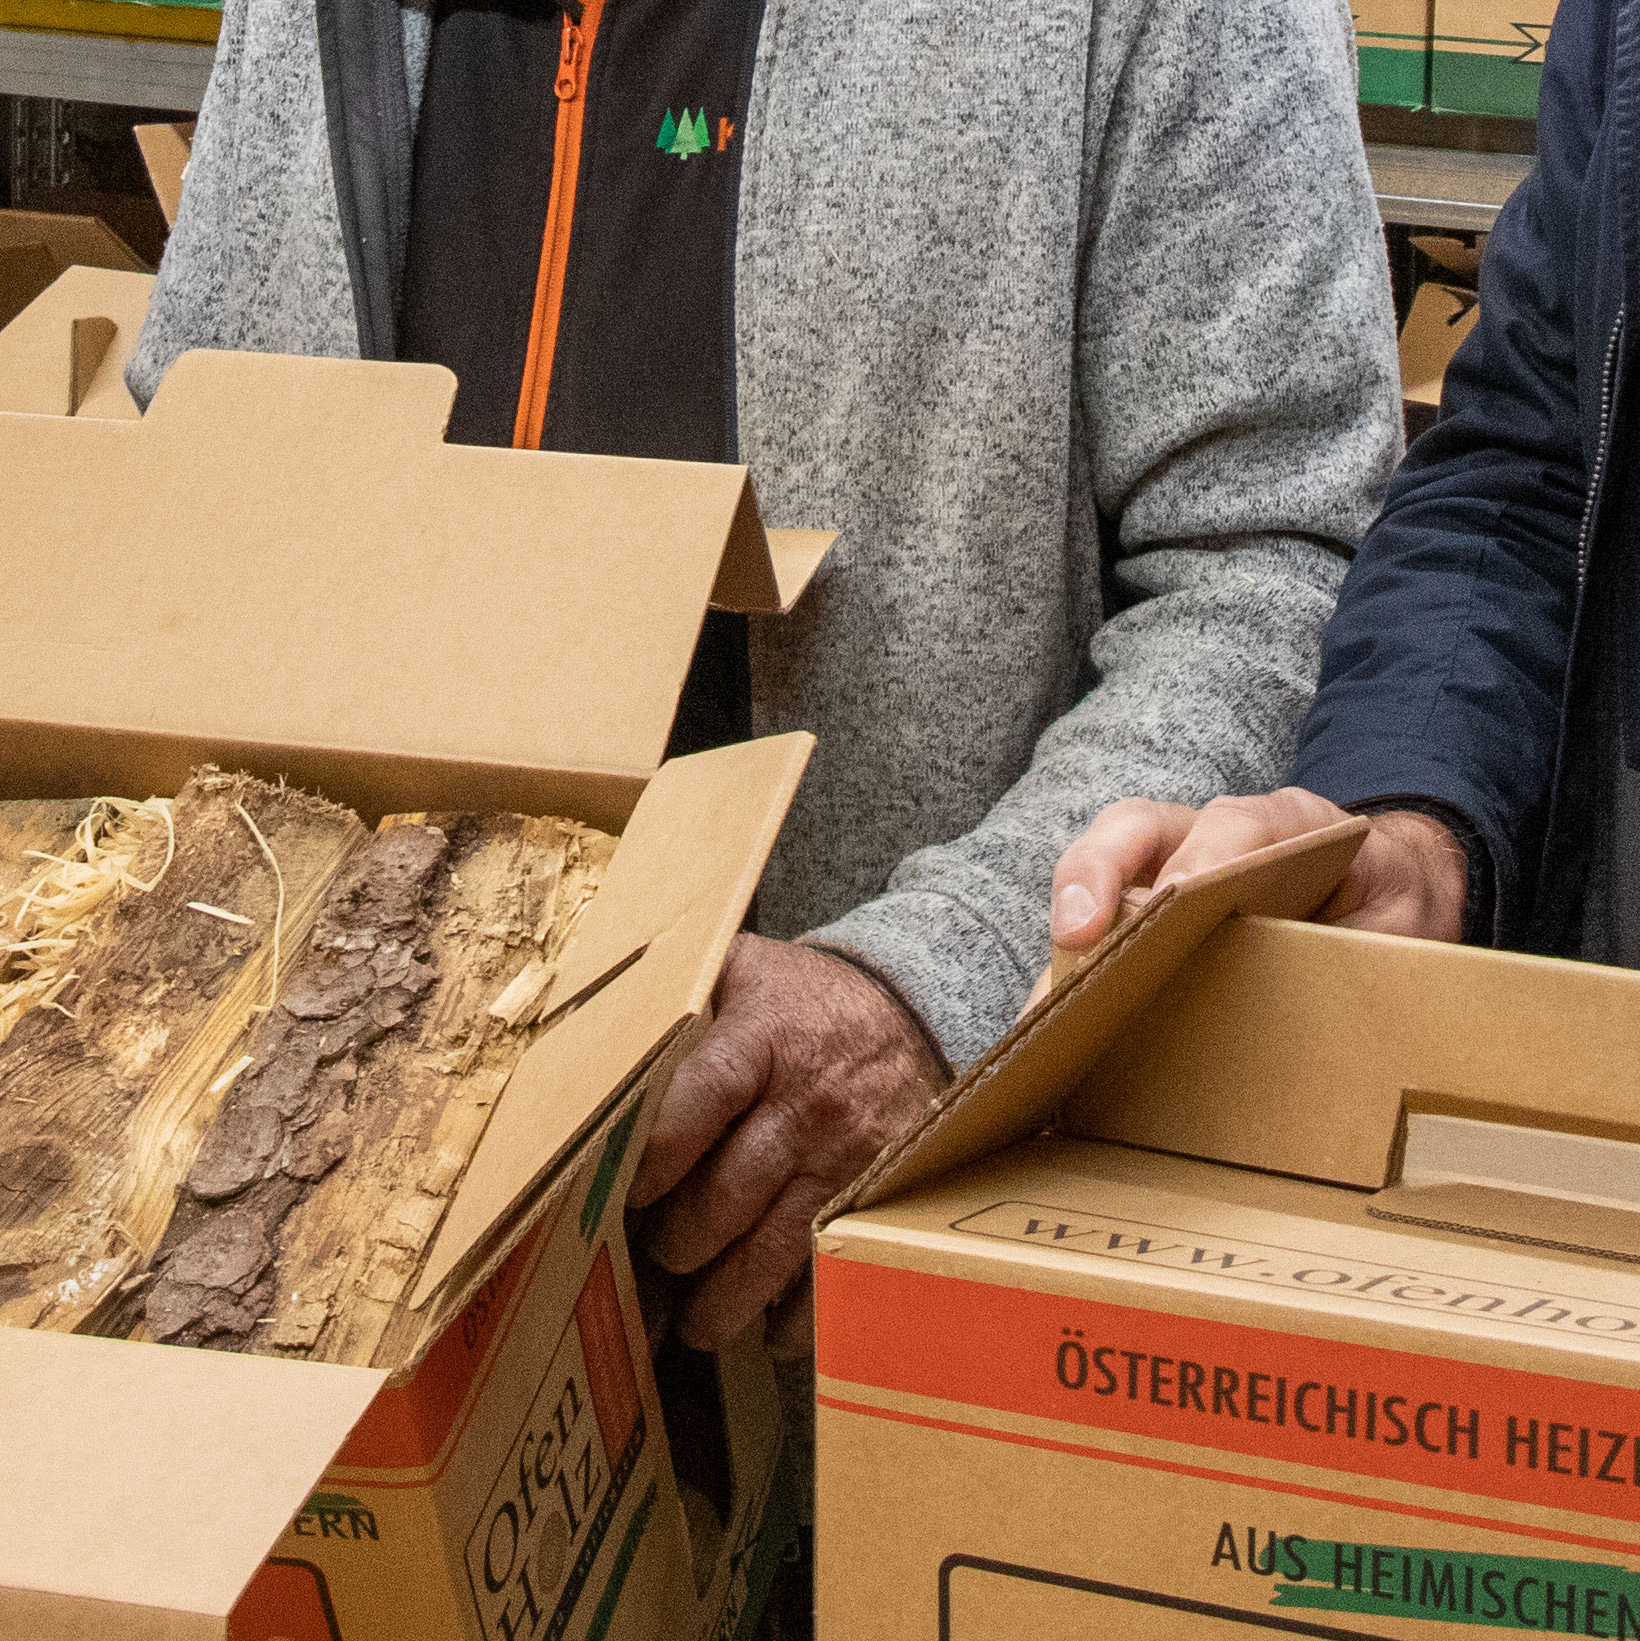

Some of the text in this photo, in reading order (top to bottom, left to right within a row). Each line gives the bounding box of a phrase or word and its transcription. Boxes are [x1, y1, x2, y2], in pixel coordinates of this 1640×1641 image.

[1055, 1327, 1480, 1460] ÖSTERREICHISCH
[484, 1375, 583, 1595] Ofen
[1211, 1520, 1309, 1583] AUS
